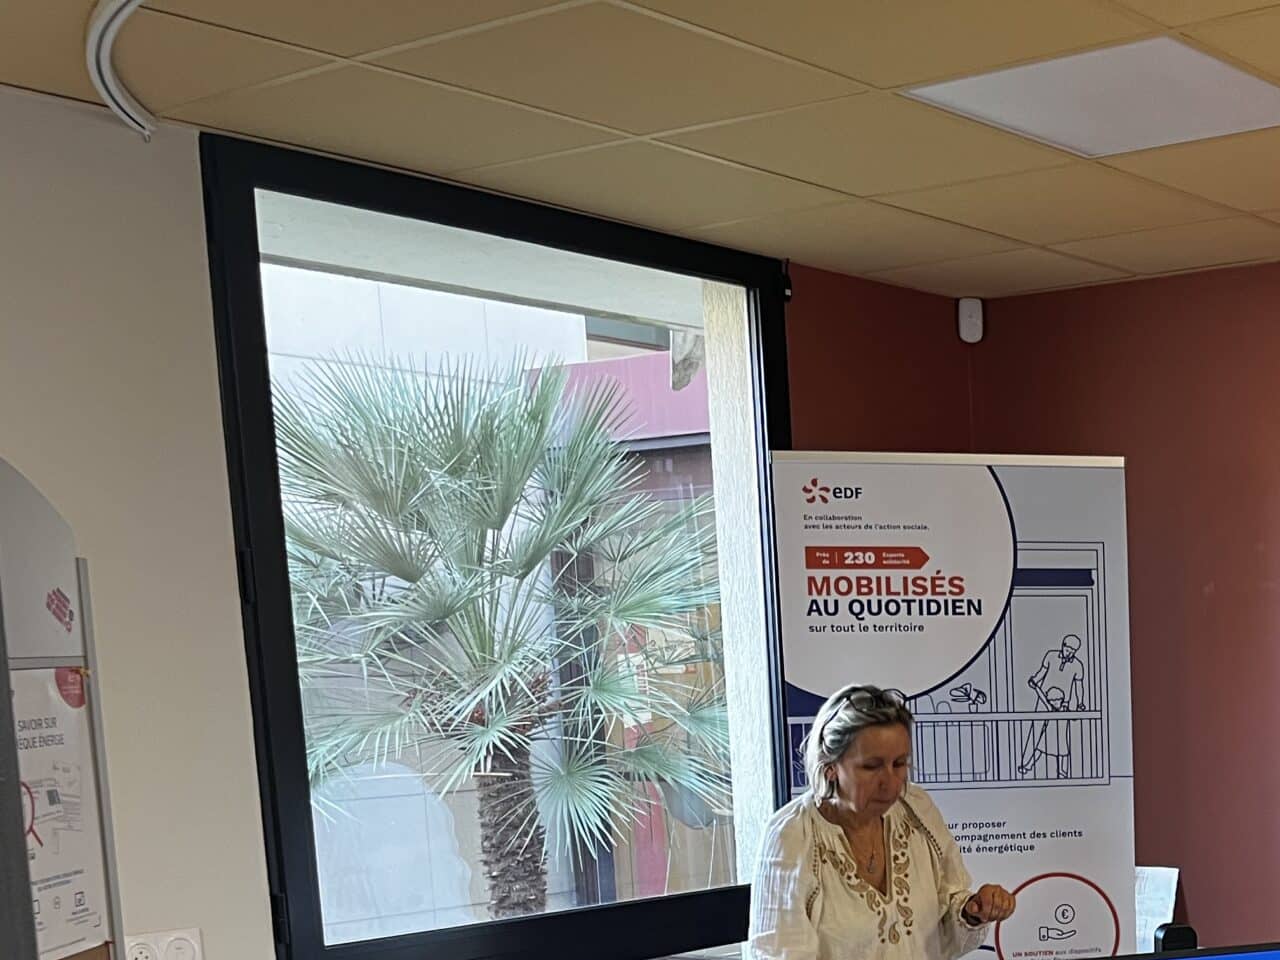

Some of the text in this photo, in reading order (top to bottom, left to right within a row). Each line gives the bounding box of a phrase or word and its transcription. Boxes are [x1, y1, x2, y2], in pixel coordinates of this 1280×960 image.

[843, 552, 876, 565] 230
[807, 570, 965, 597] MOBILISÉS
[807, 599, 983, 621] AU QUOTIDIEN
[809, 622, 925, 633] sur tout le territoire
[962, 821, 1007, 831] proposer
[954, 829, 1083, 843] ompagnement des clients
[976, 843, 1035, 854] énergétique
